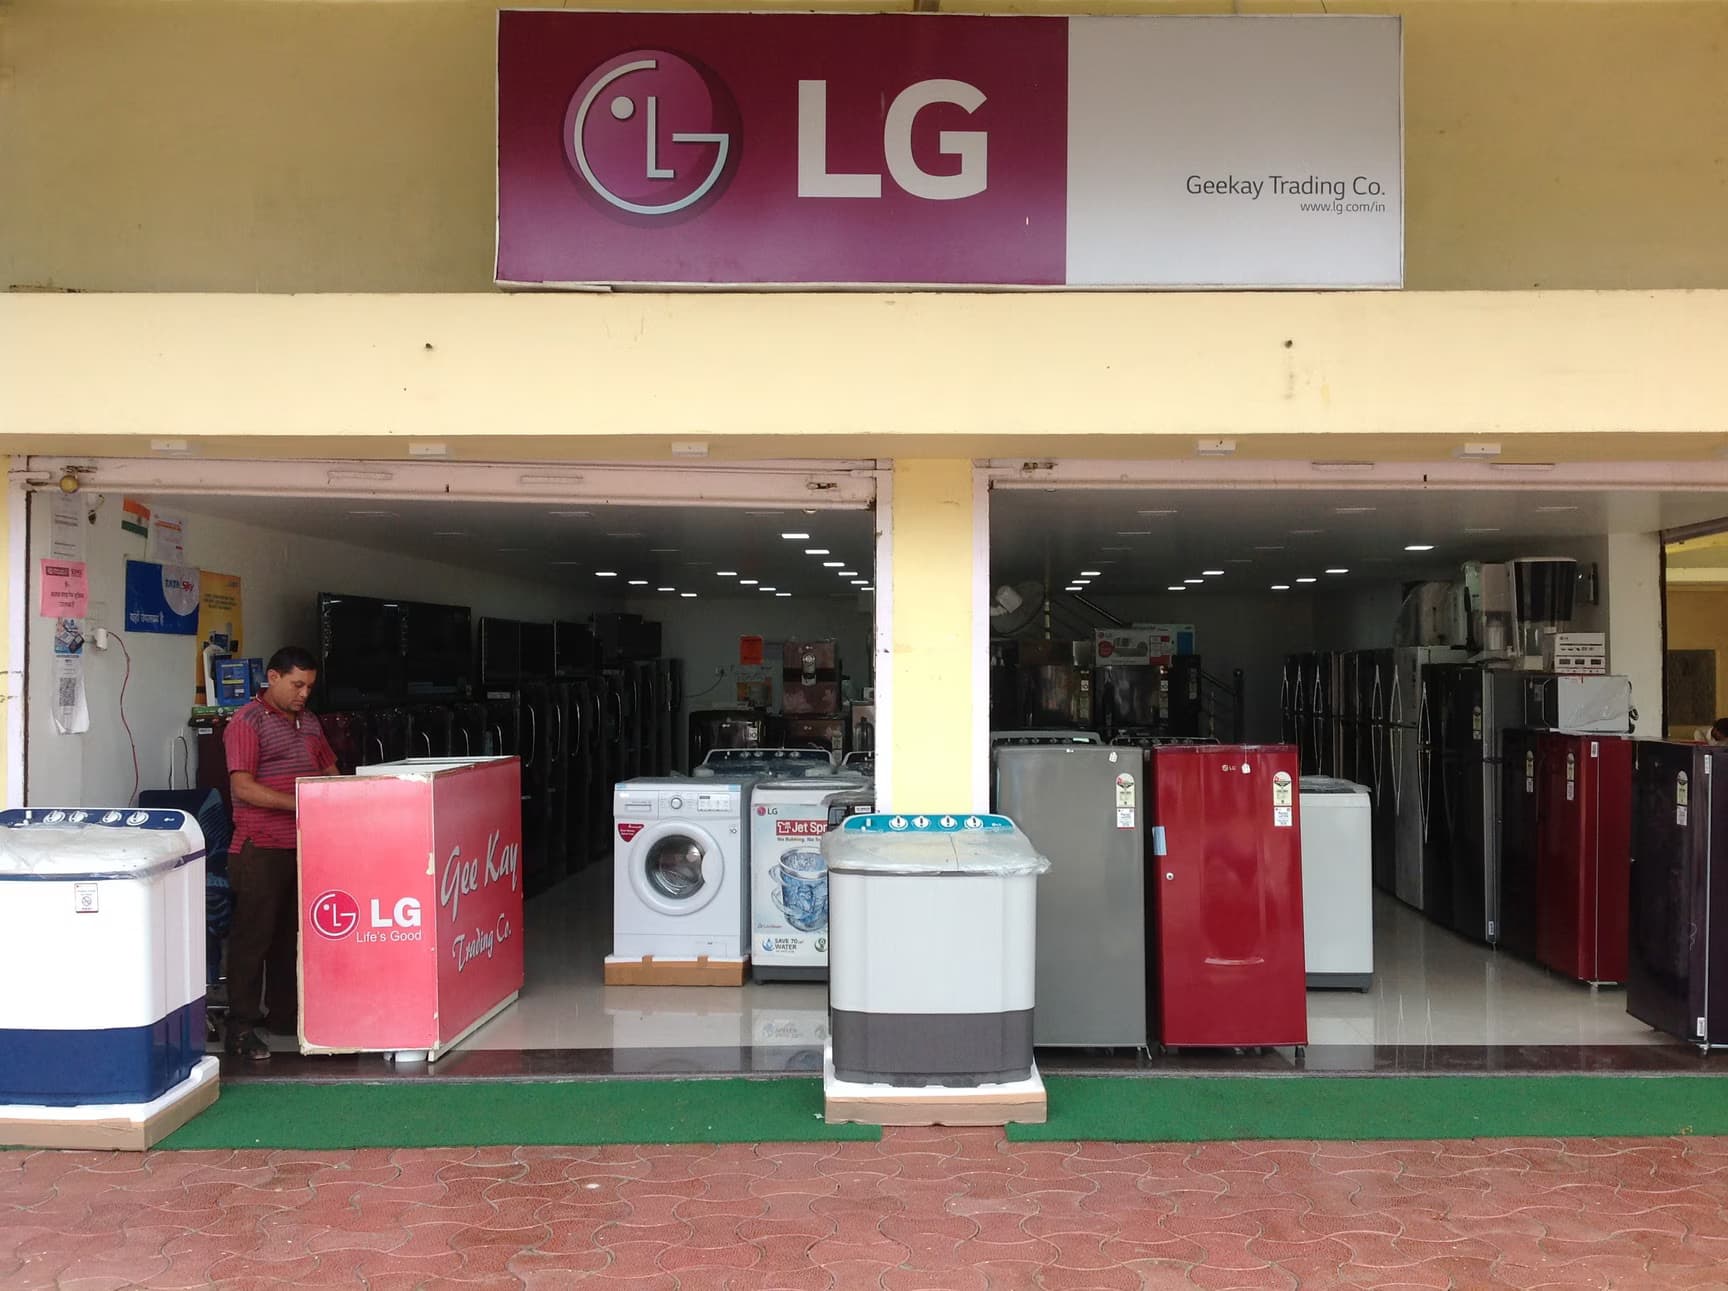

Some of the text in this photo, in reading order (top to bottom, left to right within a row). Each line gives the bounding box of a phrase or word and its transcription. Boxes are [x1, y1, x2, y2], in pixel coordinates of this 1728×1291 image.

[798, 79, 988, 200] LG
[1186, 175, 1386, 201] Geekay Trading Co.
[792, 821, 828, 835] Jet Spr
[441, 829, 519, 923] Gee Kay
[370, 896, 421, 928] LG
[356, 929, 422, 943] Life's Good
[452, 912, 512, 972] Trading Co.
